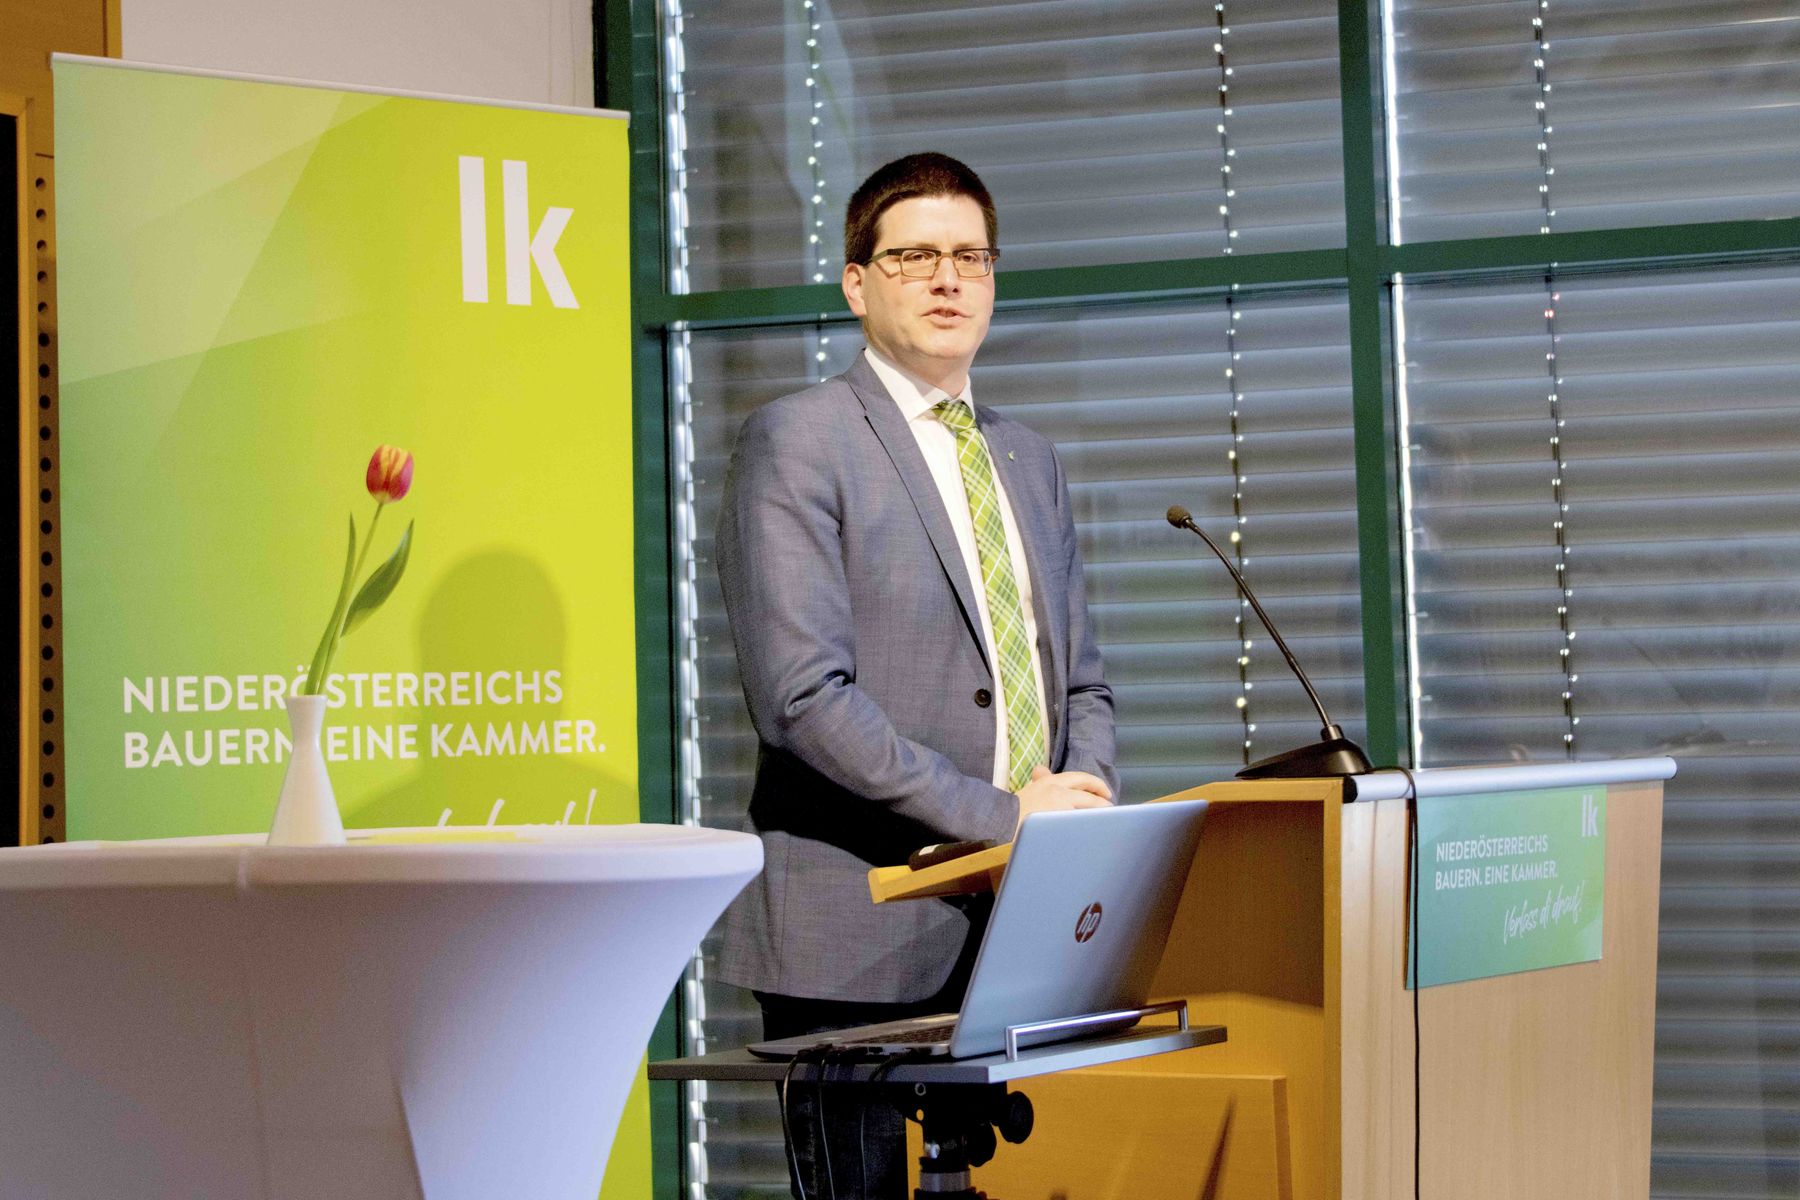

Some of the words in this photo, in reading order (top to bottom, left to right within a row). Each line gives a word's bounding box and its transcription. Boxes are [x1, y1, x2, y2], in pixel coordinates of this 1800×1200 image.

[458, 155, 581, 309] lk
[327, 724, 418, 761] EINE
[431, 719, 606, 757] KAMMER.
[1436, 834, 1548, 862] NIEDERÖSTERREICHS
[1435, 869, 1482, 890] BAUERN.
[1485, 864, 1509, 885] EINE
[1511, 860, 1558, 881] KAMMER.
[1077, 903, 1100, 942] hp
